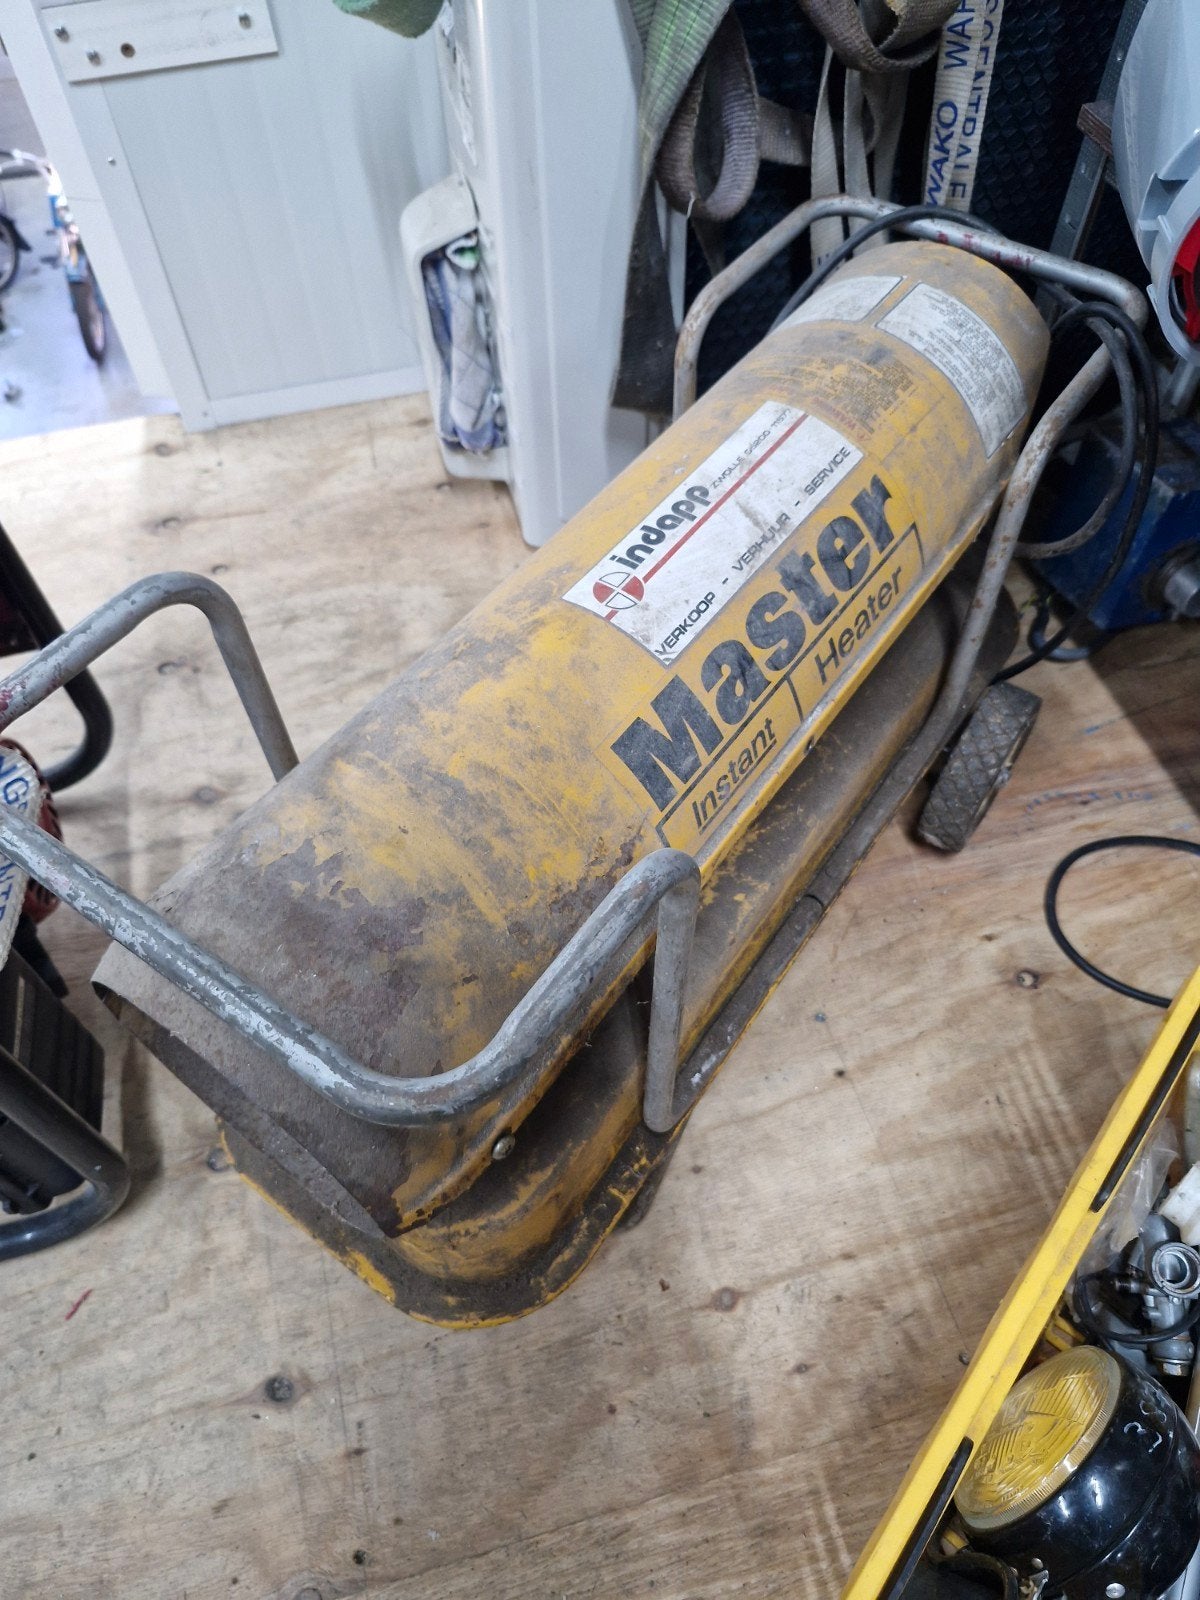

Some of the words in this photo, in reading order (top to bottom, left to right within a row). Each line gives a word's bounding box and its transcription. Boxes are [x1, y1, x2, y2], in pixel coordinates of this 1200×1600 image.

[926, 101, 958, 207] WAKO
[609, 486, 711, 570] indapp
[712, 456, 745, 489] ZWOLLE
[655, 591, 716, 656] VERKOOP
[732, 512, 791, 572] VERHUUR
[804, 447, 851, 496] SERVICE
[610, 474, 895, 812] Master
[691, 717, 777, 829] Instant
[814, 566, 902, 686] Heater
